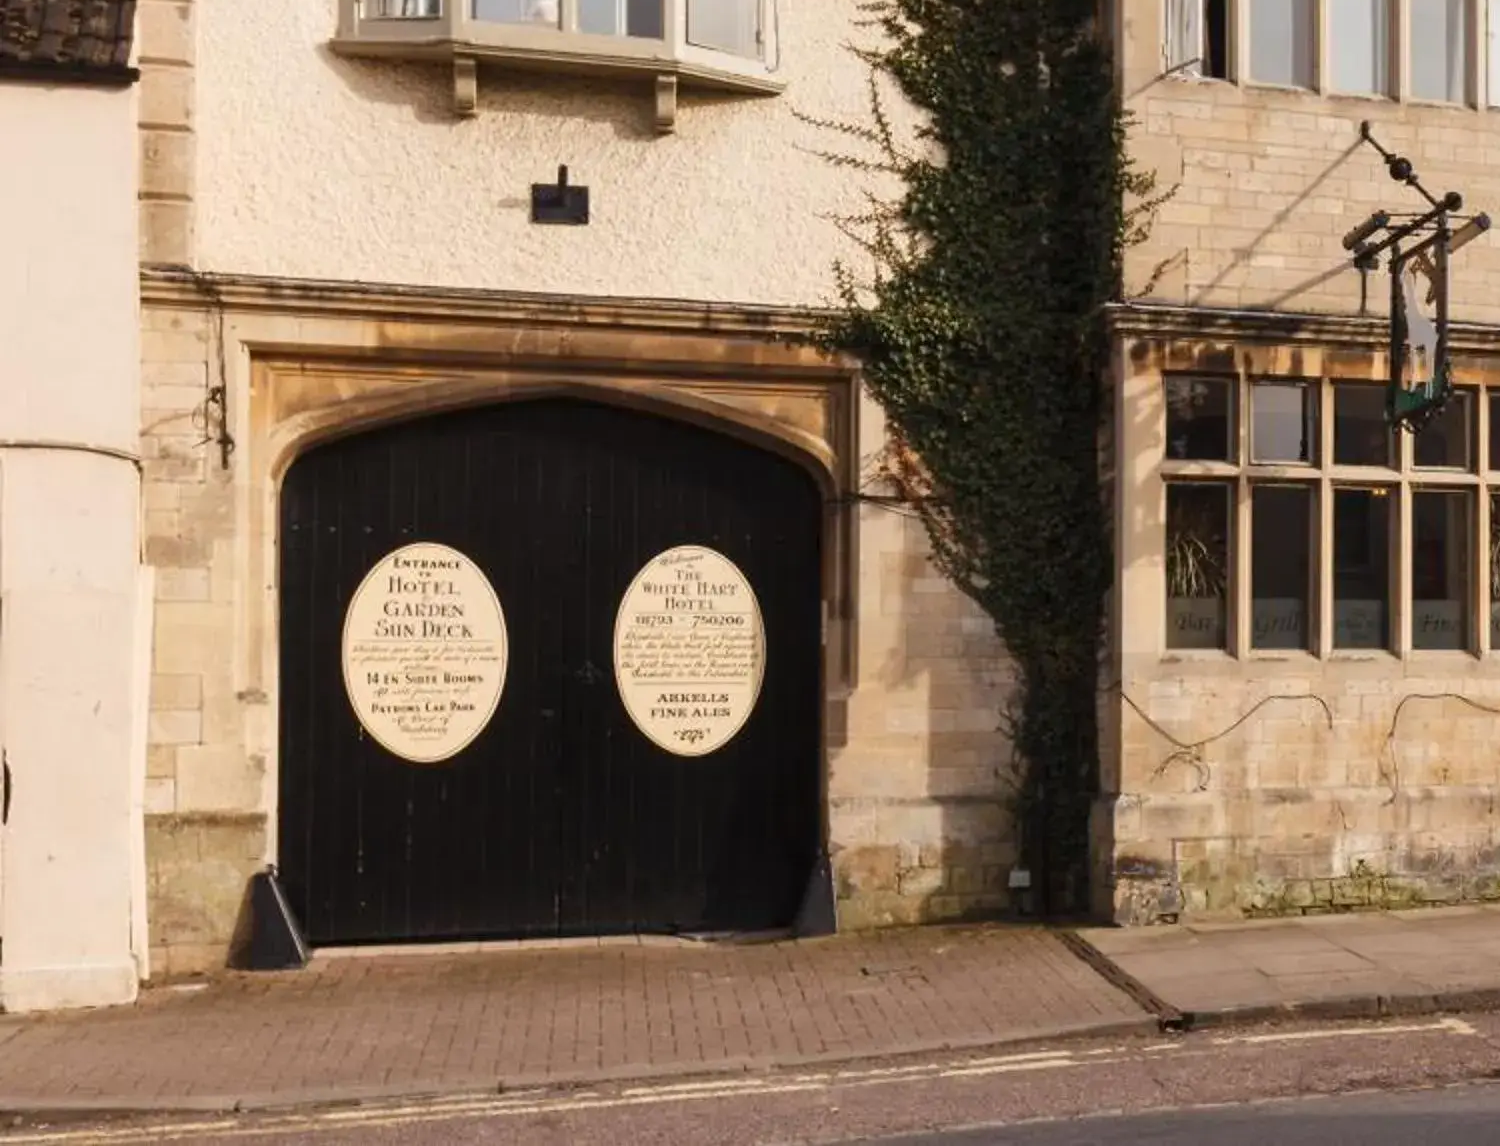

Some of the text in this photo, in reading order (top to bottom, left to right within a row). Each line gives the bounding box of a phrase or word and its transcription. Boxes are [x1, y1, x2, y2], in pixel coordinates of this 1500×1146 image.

[387, 574, 461, 596] HOTEL
[642, 581, 740, 597] WHITE HART
[382, 598, 465, 618] GARDEN
[664, 597, 714, 612] HOTEL
[374, 618, 474, 640] SUN DECK
